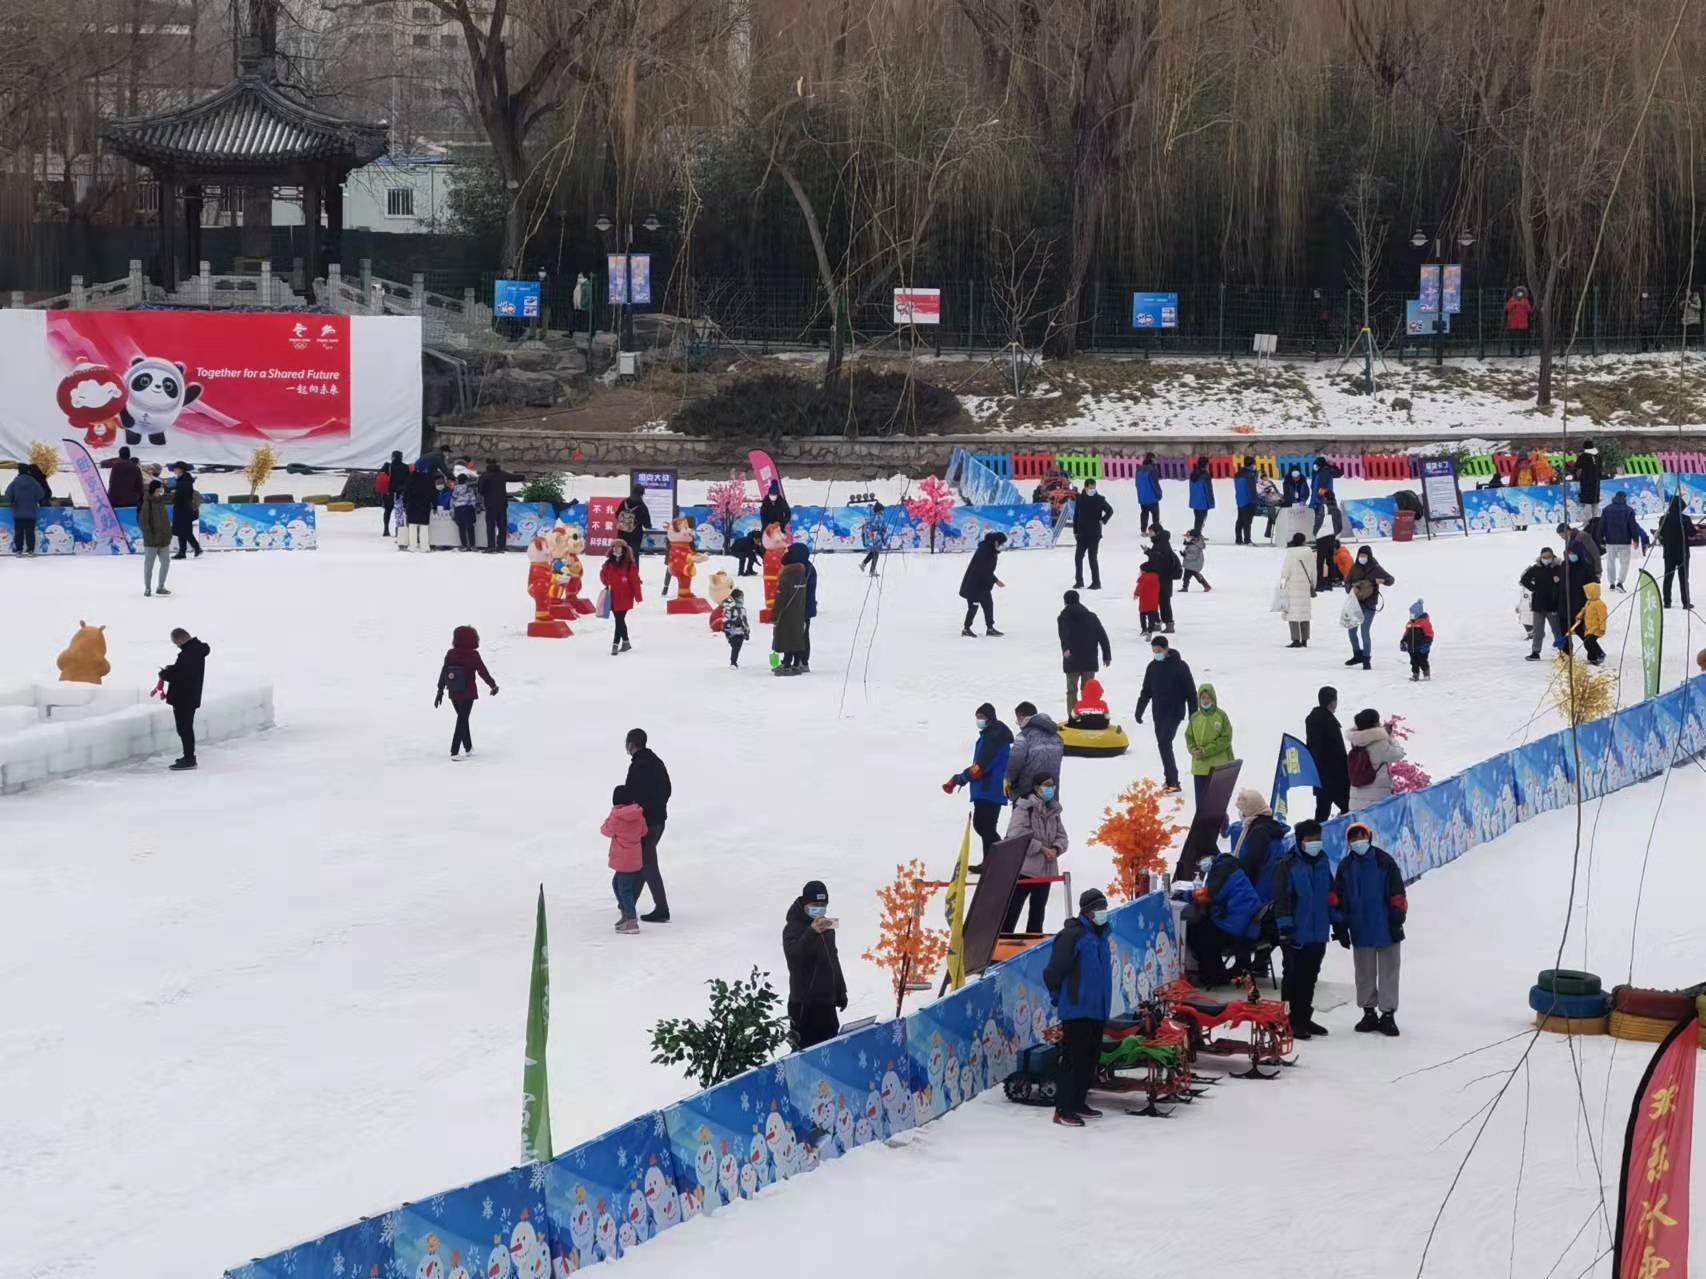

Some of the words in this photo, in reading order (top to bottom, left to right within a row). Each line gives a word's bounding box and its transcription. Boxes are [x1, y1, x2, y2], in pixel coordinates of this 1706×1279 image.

[197, 367, 241, 379] Together
[244, 368, 258, 378] for
[268, 368, 305, 379] Shared
[307, 369, 340, 380] Future
[285, 384, 340, 396] 一起向未来
